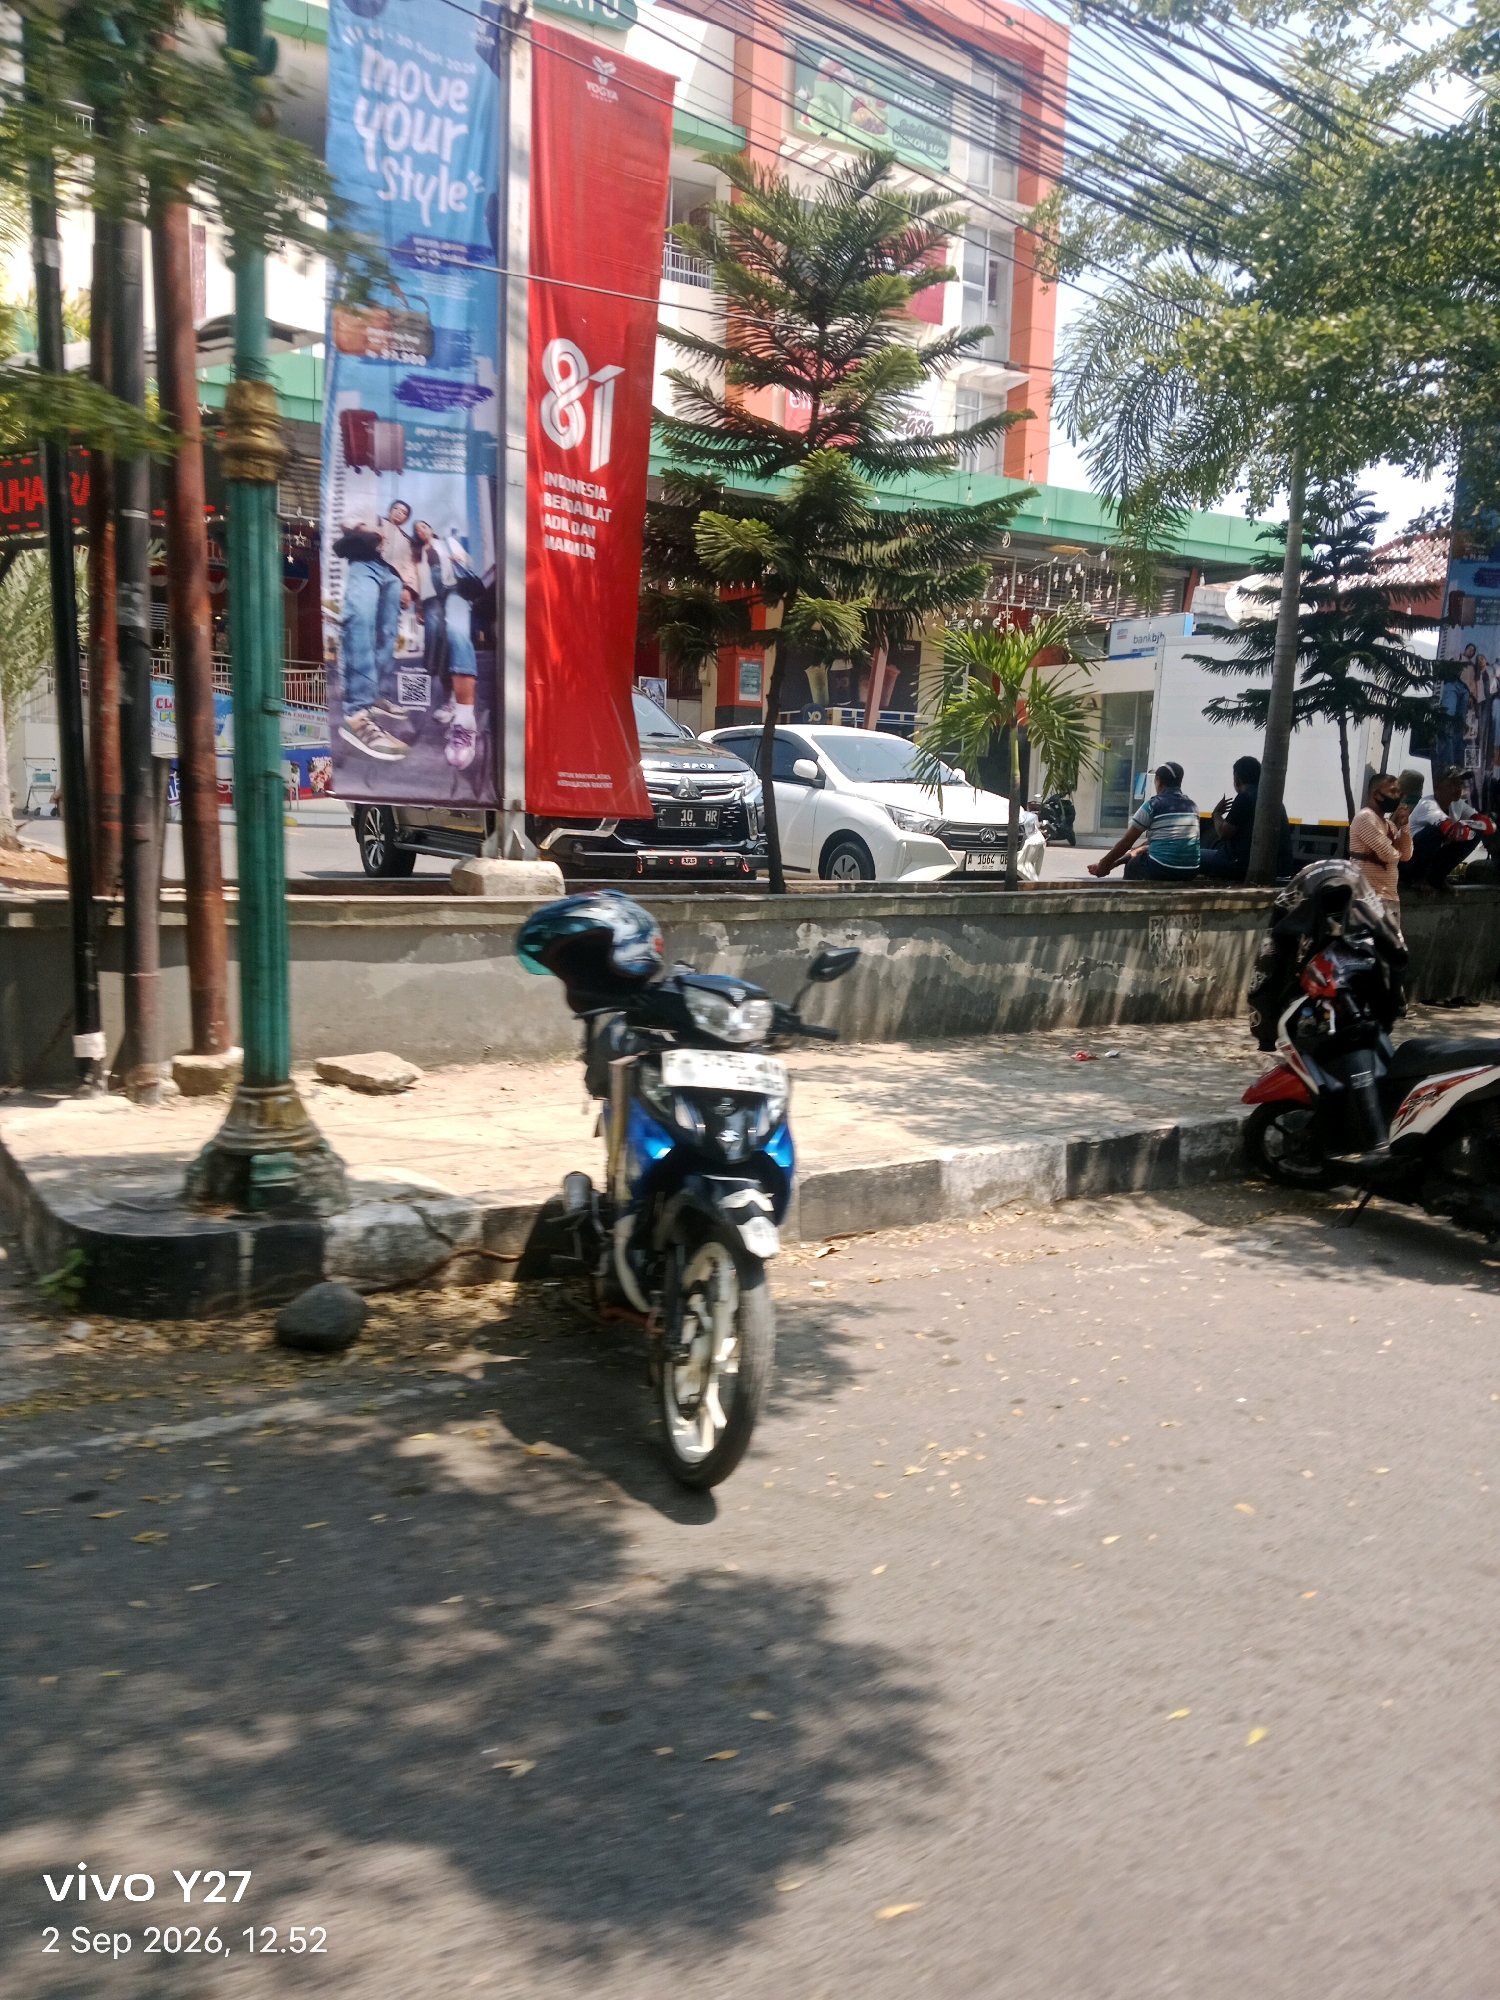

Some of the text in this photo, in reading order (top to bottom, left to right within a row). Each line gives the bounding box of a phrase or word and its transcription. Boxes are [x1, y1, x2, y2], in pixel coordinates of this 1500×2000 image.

[361, 44, 469, 113] move
[585, 80, 618, 100] YOGYA
[353, 95, 469, 172] your
[894, 134, 947, 156] DISKON 10%
[376, 155, 469, 227] style
[541, 338, 626, 473] 81
[544, 471, 608, 501] INDONESIA
[543, 492, 612, 522] BERDAULAT
[544, 513, 596, 540] ADIL DAN
[544, 534, 596, 560] MAKMUR
[681, 809, 694, 822] 10
[705, 810, 718, 822] HR
[967, 854, 972, 864] A
[978, 854, 996, 865] 1064
